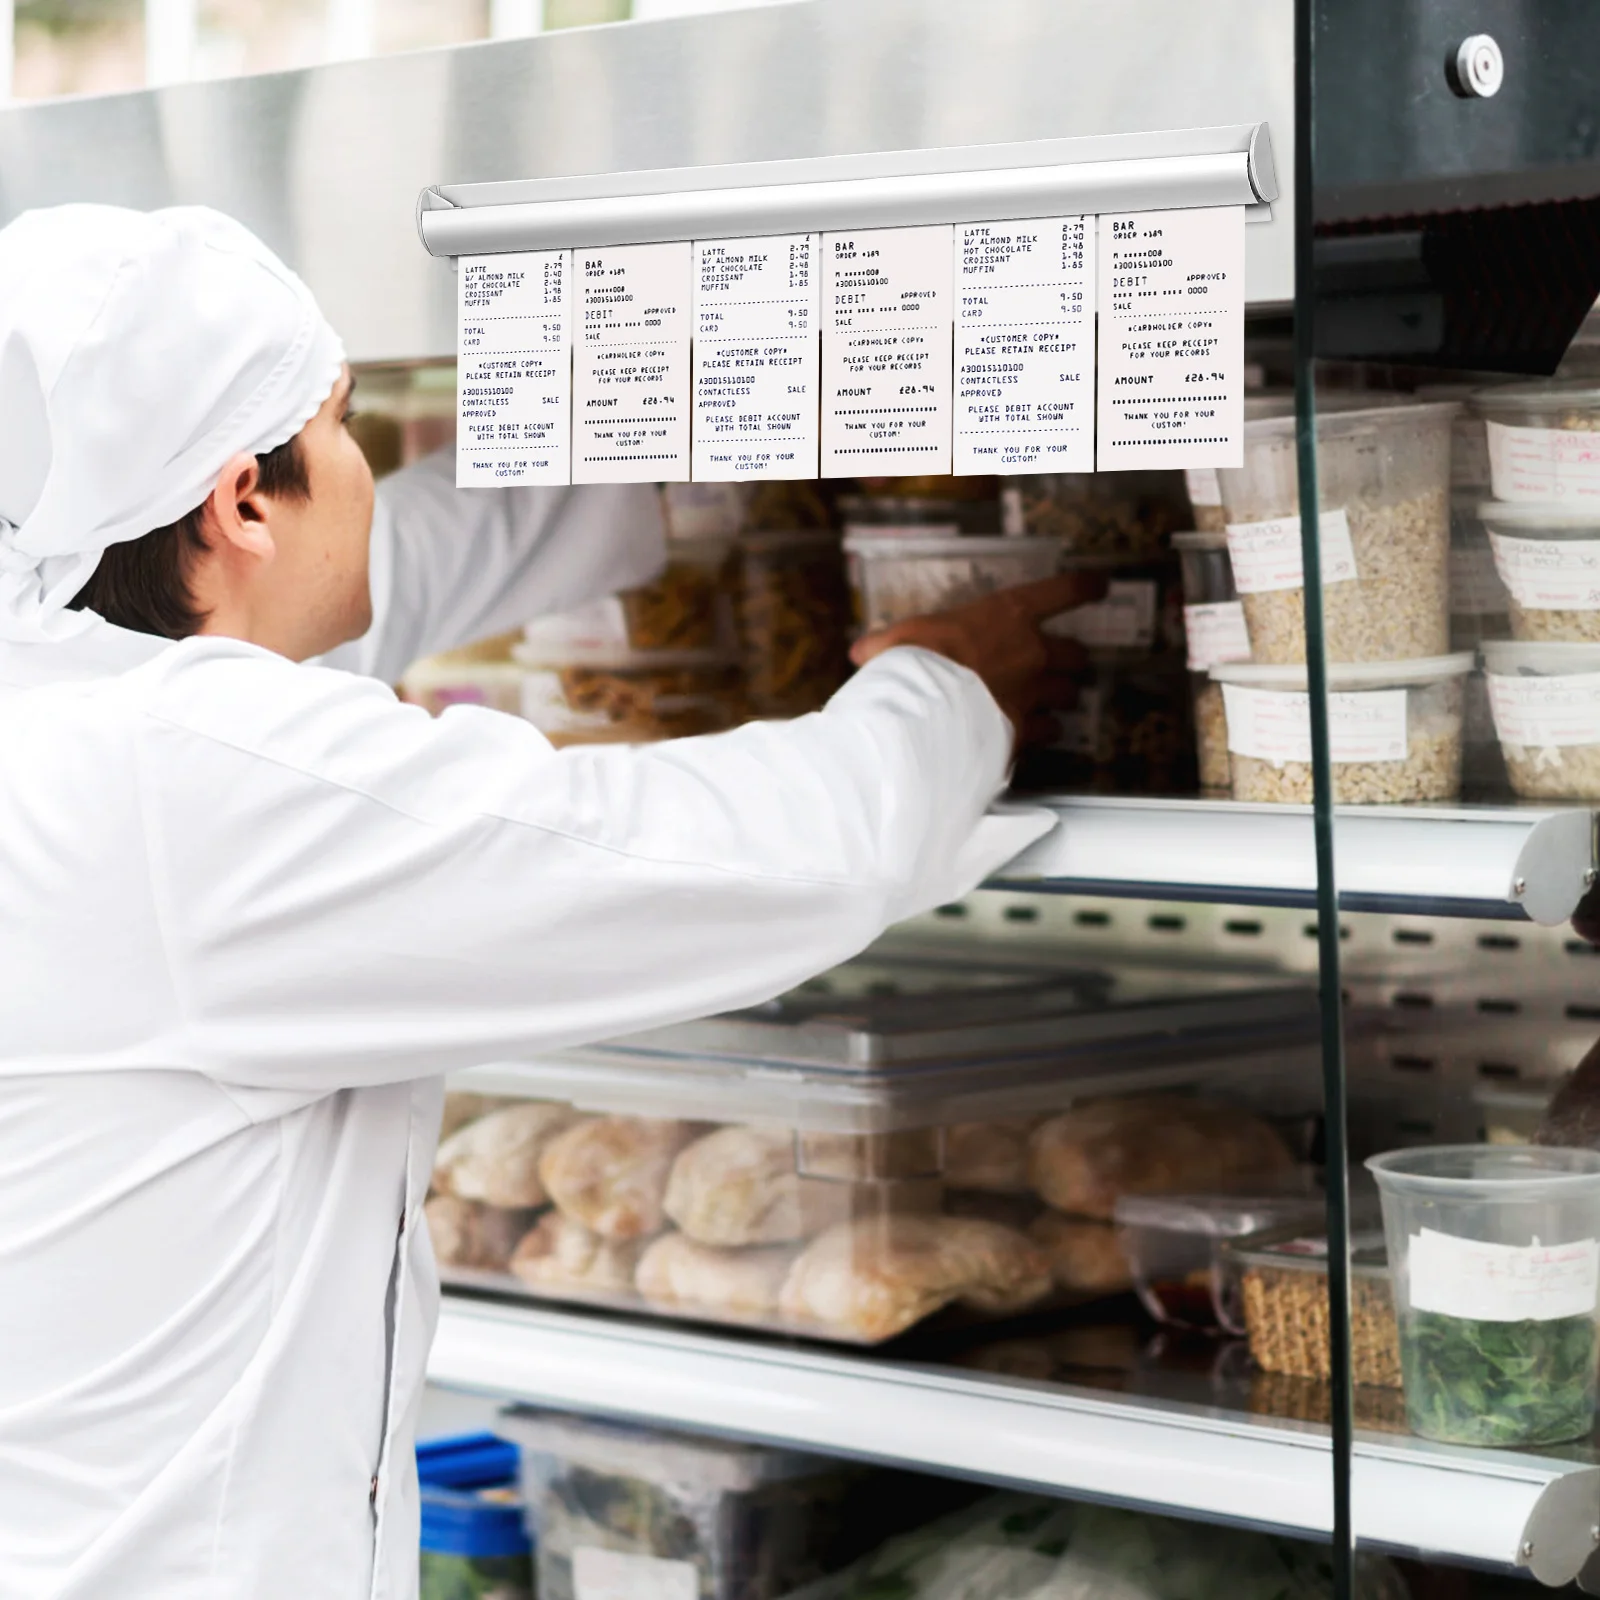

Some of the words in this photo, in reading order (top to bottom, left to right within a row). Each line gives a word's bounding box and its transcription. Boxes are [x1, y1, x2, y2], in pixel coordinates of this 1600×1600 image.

[965, 228, 990, 237] LATTE
[1062, 224, 1084, 233] 2.79
[1113, 221, 1135, 232] BAR
[980, 236, 1012, 245] ALMOND
[1016, 235, 1038, 244] MILK
[1062, 233, 1084, 242] 0.40
[702, 248, 726, 256] LATTE
[790, 244, 810, 252] 2.79
[835, 242, 855, 252] BAR
[964, 247, 980, 255] HOT
[985, 244, 1032, 254] CHOCOLATE
[1062, 242, 1084, 251] 2.48
[716, 256, 744, 264] ALMOND
[749, 255, 768, 263] MILK
[790, 252, 809, 261] 0.40
[964, 255, 1011, 265] CROISSANT
[1062, 251, 1084, 260] 1.98
[466, 266, 487, 274] LATTE
[544, 262, 563, 270] 2.79
[586, 260, 603, 270] BAR
[720, 264, 763, 273] CHOCOLATE
[789, 261, 809, 270] 2.48
[963, 266, 995, 274] MUFFIN
[1062, 261, 1083, 270] 1.85
[478, 273, 504, 281] ALMOND
[508, 272, 525, 280] MILK
[544, 270, 562, 278] 0.40
[702, 273, 744, 283] CROISSANT
[790, 270, 809, 279] 1.98
[1114, 276, 1148, 288] DEBIT
[1187, 273, 1227, 282] APPROVED
[466, 282, 478, 290] HOT
[482, 280, 520, 289] CHOCOLATE
[544, 279, 562, 287] 2.48
[701, 283, 730, 292] MUFFIN
[789, 279, 809, 288] 1.85
[465, 290, 503, 299] CROISSANT
[544, 287, 562, 295] 1.98
[1188, 286, 1208, 295] 0000
[465, 299, 491, 307] MUFFIN
[544, 296, 562, 304] 1.85
[835, 294, 866, 305] DEBIT
[963, 297, 989, 305] TOTAL
[1060, 292, 1083, 301] 9.50
[902, 303, 920, 312] 0000
[962, 310, 983, 318] CARD
[1061, 305, 1082, 313] 9.50
[1113, 302, 1132, 311] SALE
[586, 310, 613, 320] DEBIT
[700, 313, 724, 321] TOTAL
[788, 309, 808, 317] 9.50
[543, 324, 561, 332] 9.50
[700, 325, 719, 333] CARD
[788, 321, 807, 329] 9.50
[835, 318, 852, 327] SALE
[586, 333, 601, 341] SALE
[965, 347, 996, 356] PLEASE
[1002, 345, 1034, 354] RETAIN
[1039, 343, 1076, 353] RECEIPT
[1122, 342, 1152, 351] PLEASE
[1157, 340, 1177, 349] KEEP
[1182, 339, 1218, 348] RECEIPT
[843, 356, 870, 364] PLEASE
[875, 354, 893, 362] KEEP
[897, 353, 929, 361] RECEIPT
[1150, 350, 1170, 358] YOUR
[1175, 348, 1210, 357] RECORDS
[703, 360, 731, 368] PLEASE
[735, 359, 765, 367] RETAIN
[769, 358, 803, 366] RECEIPT
[868, 364, 886, 372] YOUR
[890, 362, 922, 371] RECORDS
[466, 372, 491, 380] PLEASE
[496, 371, 522, 379] RETAIN
[526, 370, 556, 378] RECEIPT
[961, 376, 1018, 385] CONTACTLESS
[1060, 373, 1081, 382] SALE
[1115, 375, 1154, 385] AMOUNT
[698, 387, 750, 396] CONTACTLESS
[788, 385, 806, 394] SALE
[837, 387, 872, 397] AMOUNT
[961, 389, 1002, 398] APPROVED
[462, 398, 509, 407] CONTACTLESS
[542, 396, 559, 405] SALE
[586, 398, 618, 407] AMOUNT
[698, 400, 736, 408] APPROVED
[462, 410, 497, 418] APPROVED
[968, 405, 999, 414] PLEASE
[1006, 404, 1031, 413] DEBIT
[1037, 403, 1074, 412] ACCOUNT
[739, 414, 762, 423] DEBIT
[767, 413, 801, 422] ACCOUNT
[979, 415, 1000, 423] WITH
[1005, 414, 1030, 422] TOTAL
[1037, 413, 1064, 421] SHOWN
[1174, 411, 1190, 419] FOR
[1195, 410, 1215, 418] YOUR
[499, 424, 520, 432] DEBIT
[524, 423, 554, 431] ACCOUNT
[715, 424, 734, 432] WITH
[767, 423, 792, 431] SHOWN
[908, 420, 926, 428] YOUR
[477, 433, 495, 441] WITH
[1046, 445, 1068, 453] YOUR
[1001, 455, 1037, 463] CUSTOM!
